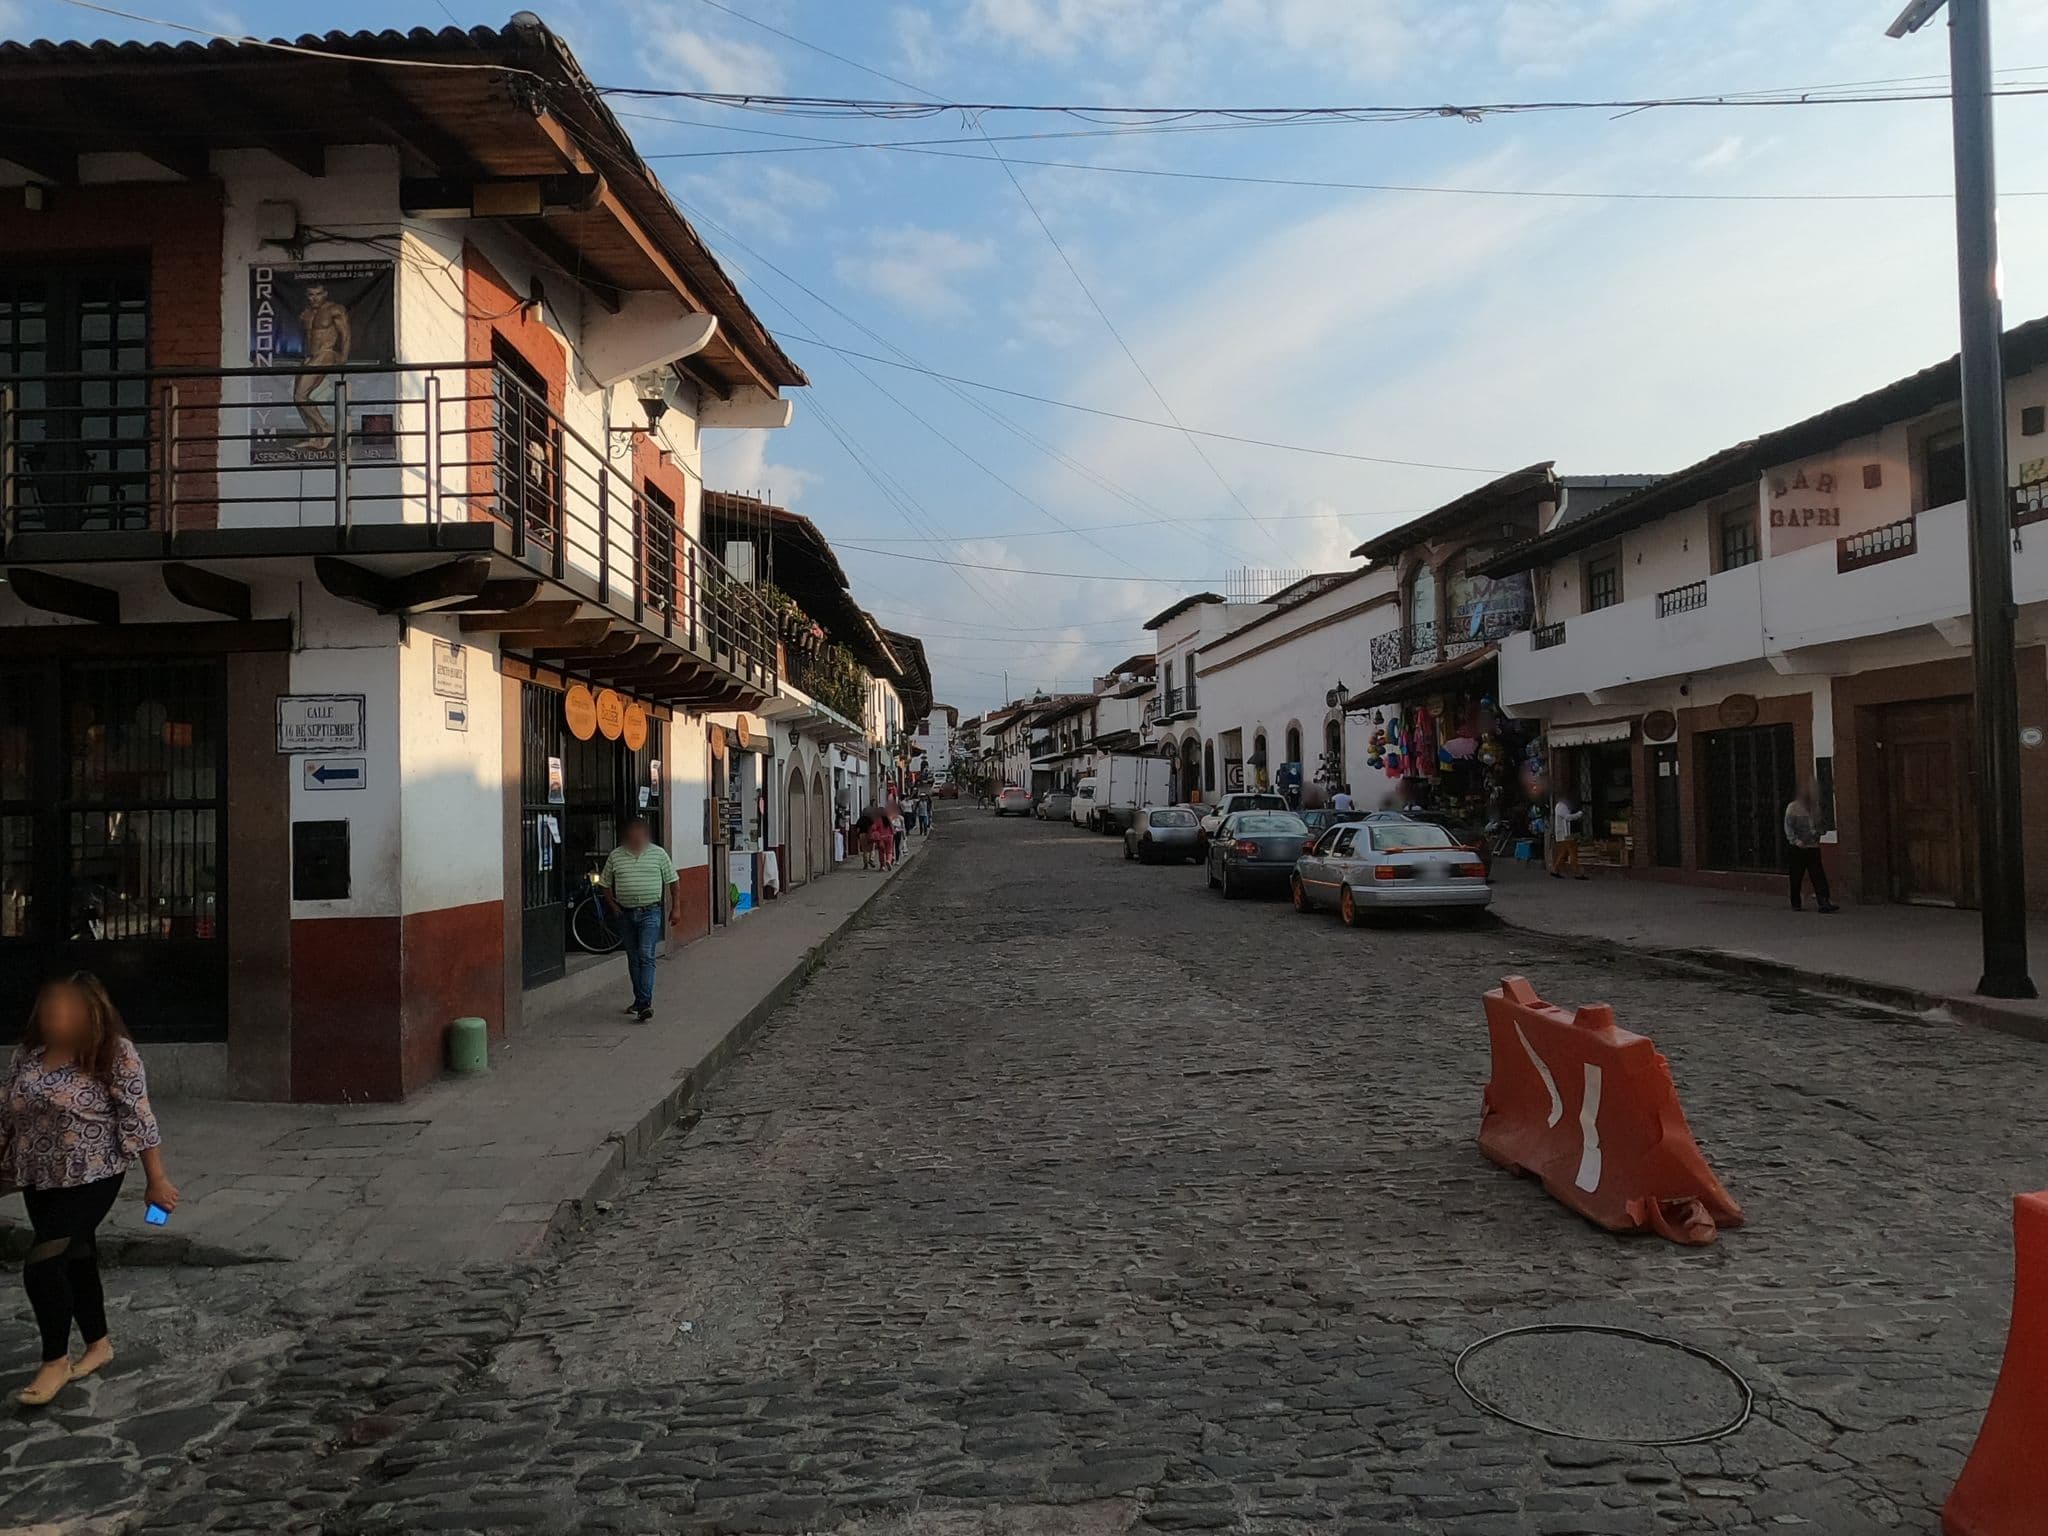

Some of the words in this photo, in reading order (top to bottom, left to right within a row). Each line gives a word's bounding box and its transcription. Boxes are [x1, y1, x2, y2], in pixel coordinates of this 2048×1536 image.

[256, 267, 274, 368] DRAGON
[303, 451, 327, 461] VENTA
[306, 706, 334, 719] CALLE
[295, 724, 305, 737] DE
[307, 723, 354, 737] SEPTIEMBRE
